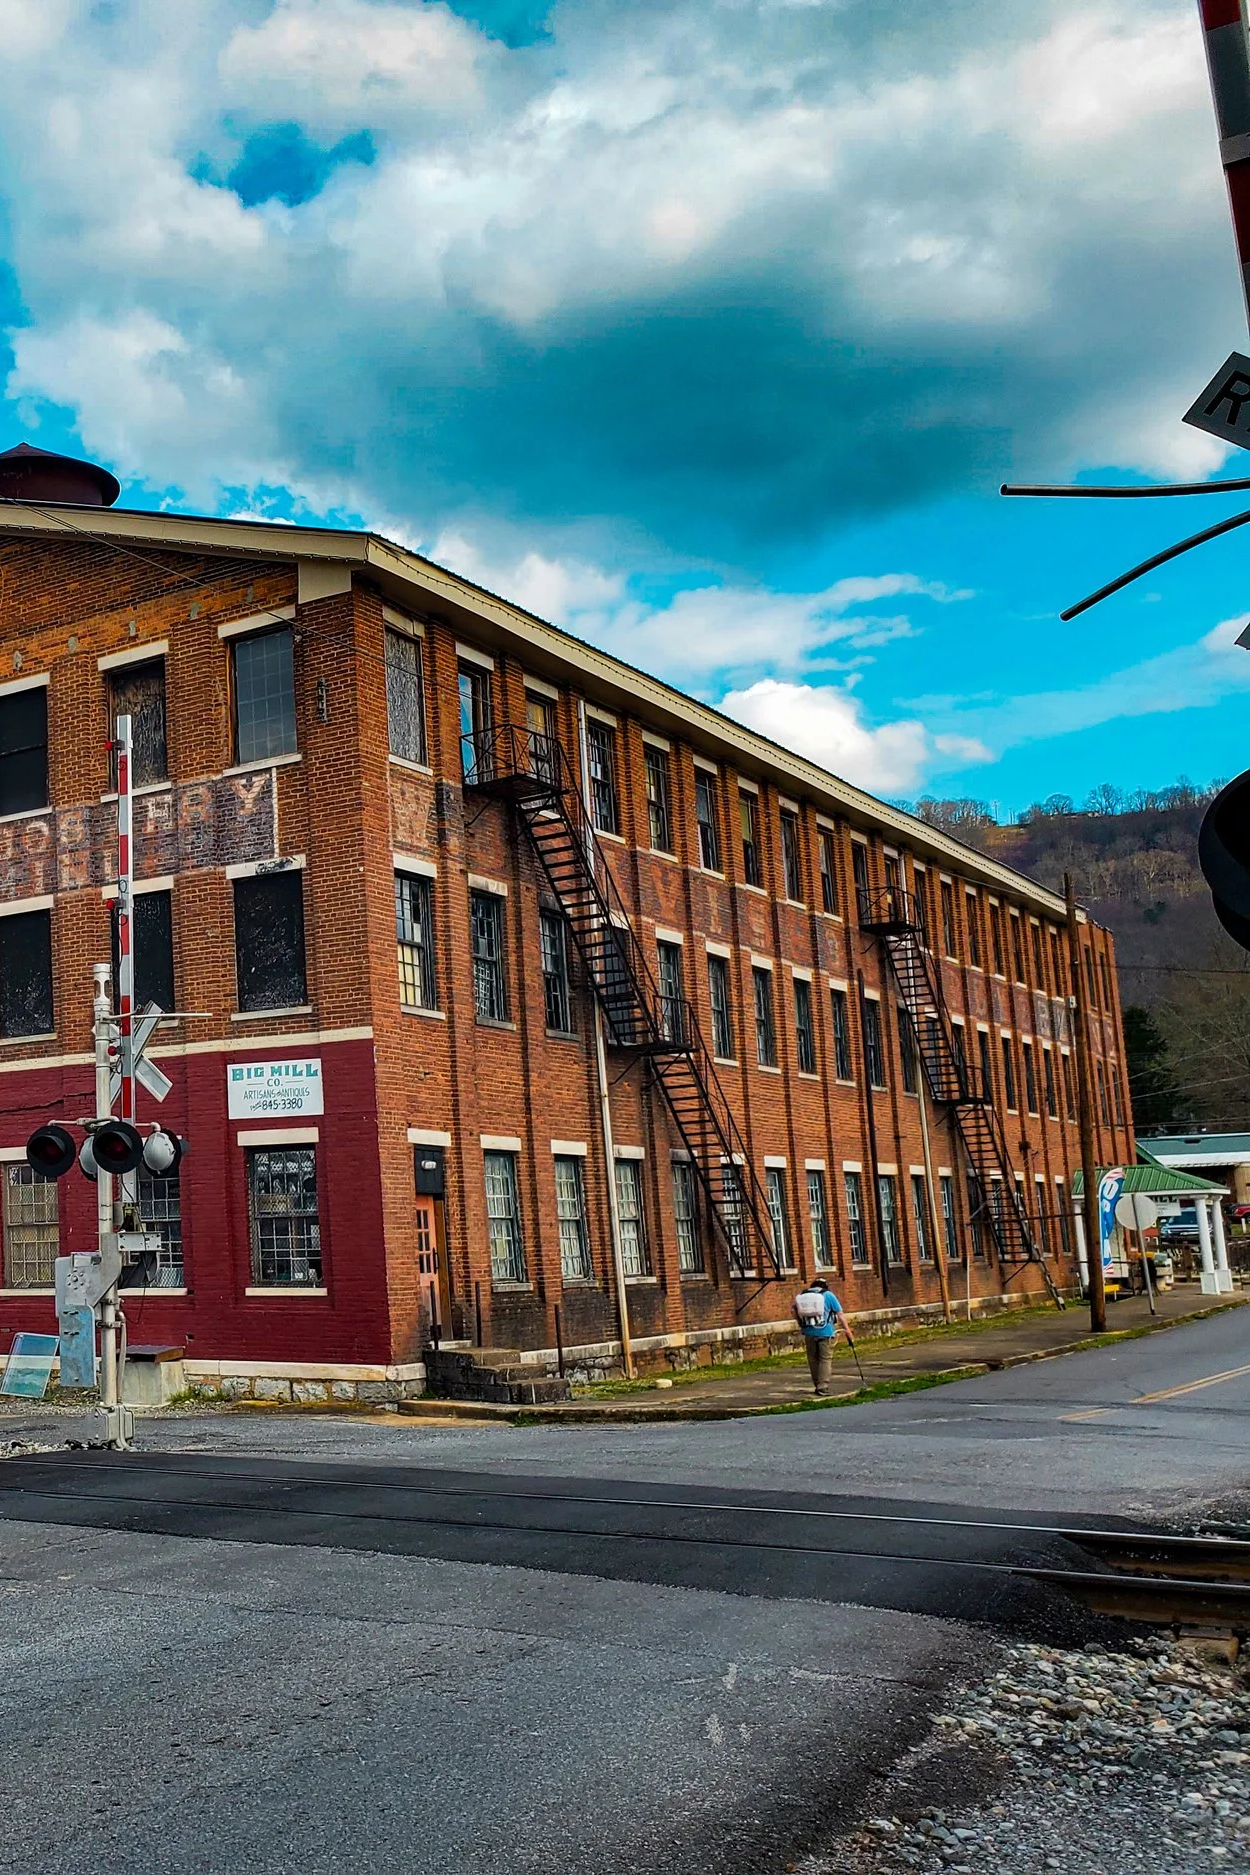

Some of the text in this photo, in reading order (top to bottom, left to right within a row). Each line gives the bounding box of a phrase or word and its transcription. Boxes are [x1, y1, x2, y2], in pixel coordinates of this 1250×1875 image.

[232, 1063, 319, 1081] BIG MILL
[266, 1078, 284, 1087] CO.
[243, 1089, 276, 1100] ARTISANS
[280, 1086, 310, 1098] ANTIQUES
